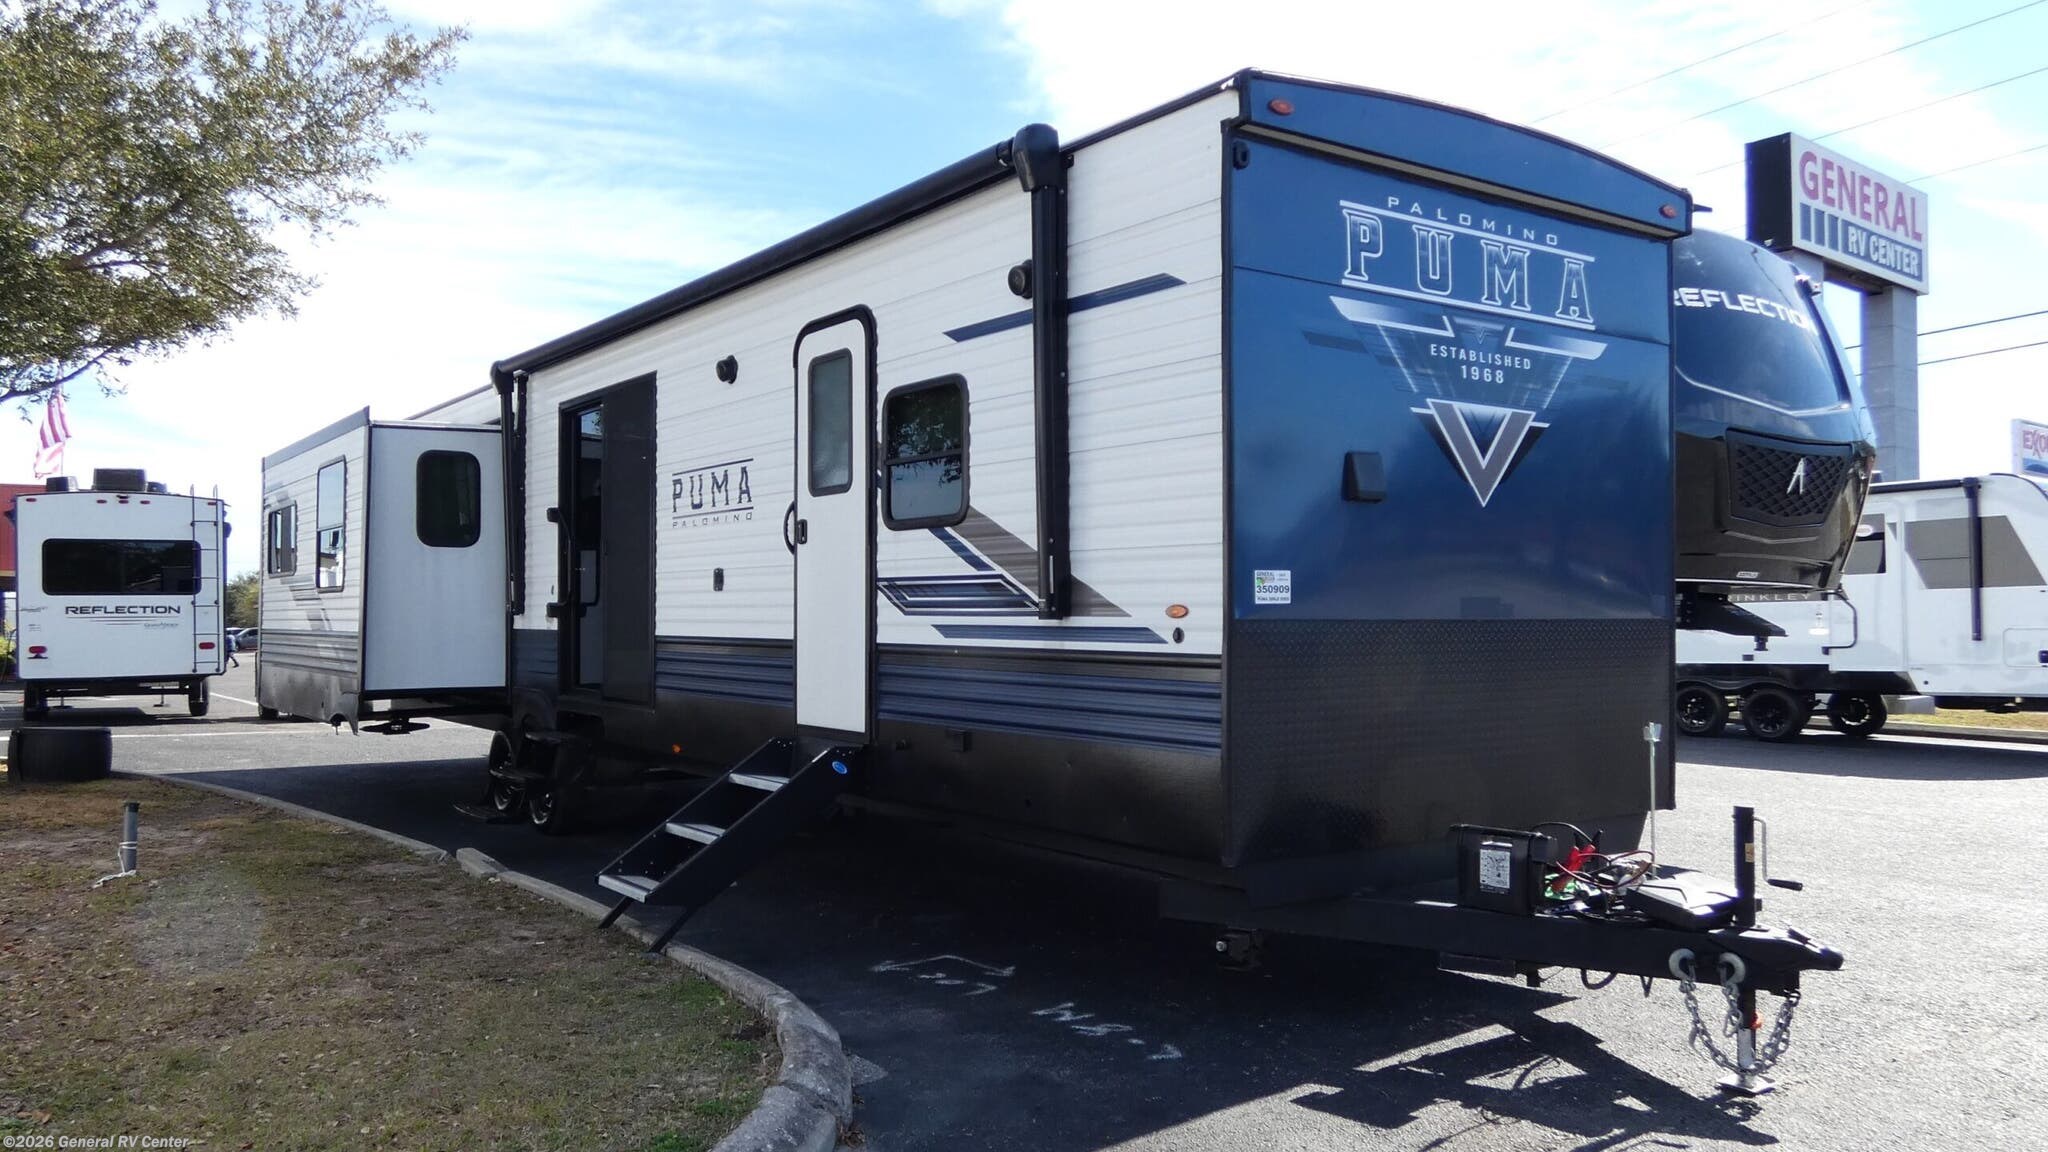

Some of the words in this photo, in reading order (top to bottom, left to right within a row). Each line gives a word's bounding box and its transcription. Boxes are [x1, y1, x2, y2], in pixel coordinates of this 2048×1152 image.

[1799, 151, 1923, 242] GENERAL
[1387, 196, 1558, 246] PALOMINO
[1342, 208, 1594, 324] PUMA
[1848, 226, 1866, 257] RV
[1869, 235, 1919, 277] CENTER
[1430, 344, 1532, 371] ESTABLISHED
[1461, 365, 1505, 384] 1968
[2022, 429, 2048, 459] EXXO
[672, 466, 753, 514] PUMA
[672, 512, 753, 529] PALOMINO
[1256, 585, 1290, 594] 350909
[65, 605, 181, 615] REFLECTION
